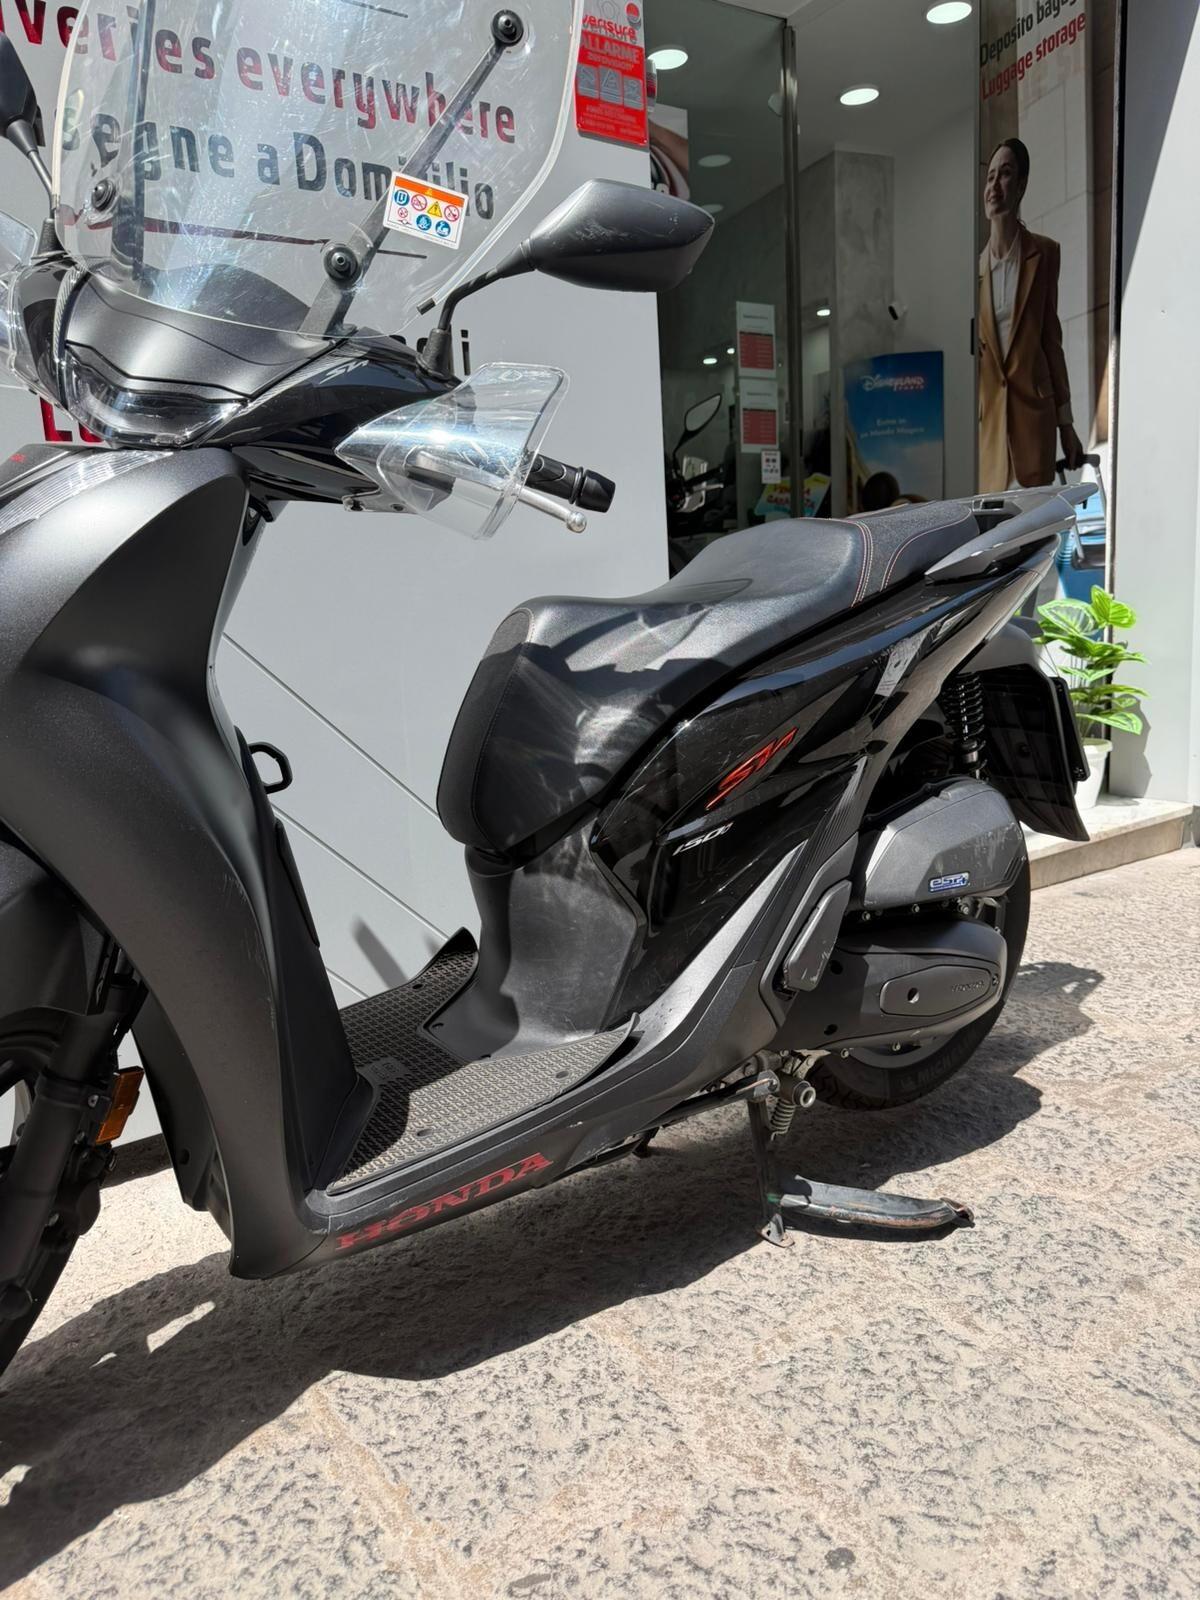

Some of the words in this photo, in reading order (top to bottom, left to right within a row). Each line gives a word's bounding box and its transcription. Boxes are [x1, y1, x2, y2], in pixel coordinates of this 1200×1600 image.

[0, 0, 216, 80] veries
[580, 32, 640, 63] ALLARME
[581, 13, 637, 38] verisure
[979, 13, 1034, 68] Deposito
[1036, 0, 1077, 24] bag
[981, 51, 1033, 100] Luggage
[1035, 13, 1087, 62] storage
[256, 143, 281, 186] a
[292, 131, 496, 220] Domlio
[335, 1152, 554, 1250] HONDA
